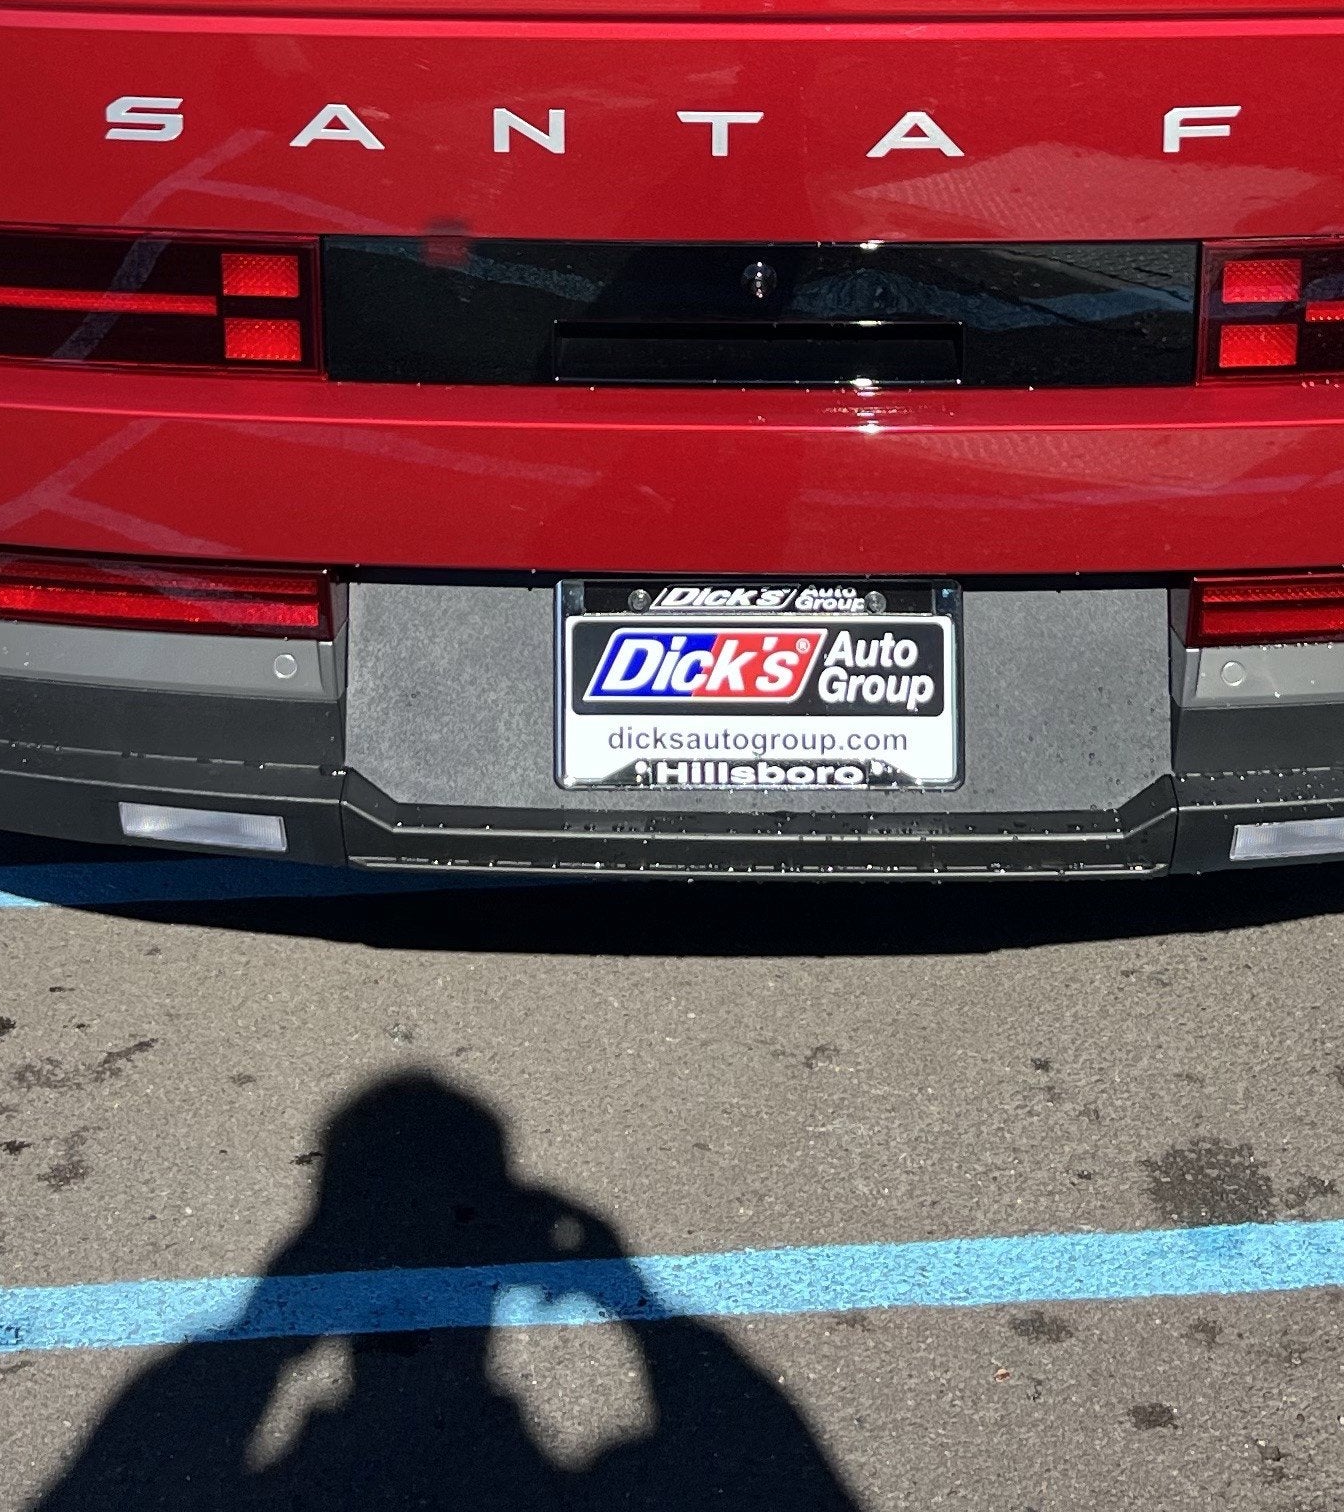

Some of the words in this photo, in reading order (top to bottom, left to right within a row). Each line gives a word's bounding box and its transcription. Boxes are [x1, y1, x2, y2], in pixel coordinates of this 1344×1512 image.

[105, 96, 963, 158] SANTA
[794, 596, 865, 612] Group
[800, 586, 857, 598] Auto
[601, 635, 801, 691] Dick's
[824, 631, 918, 668] Auto
[818, 667, 935, 710] Group
[608, 726, 908, 755] dicksautogroup.com
[656, 761, 864, 785] Hillsboro
